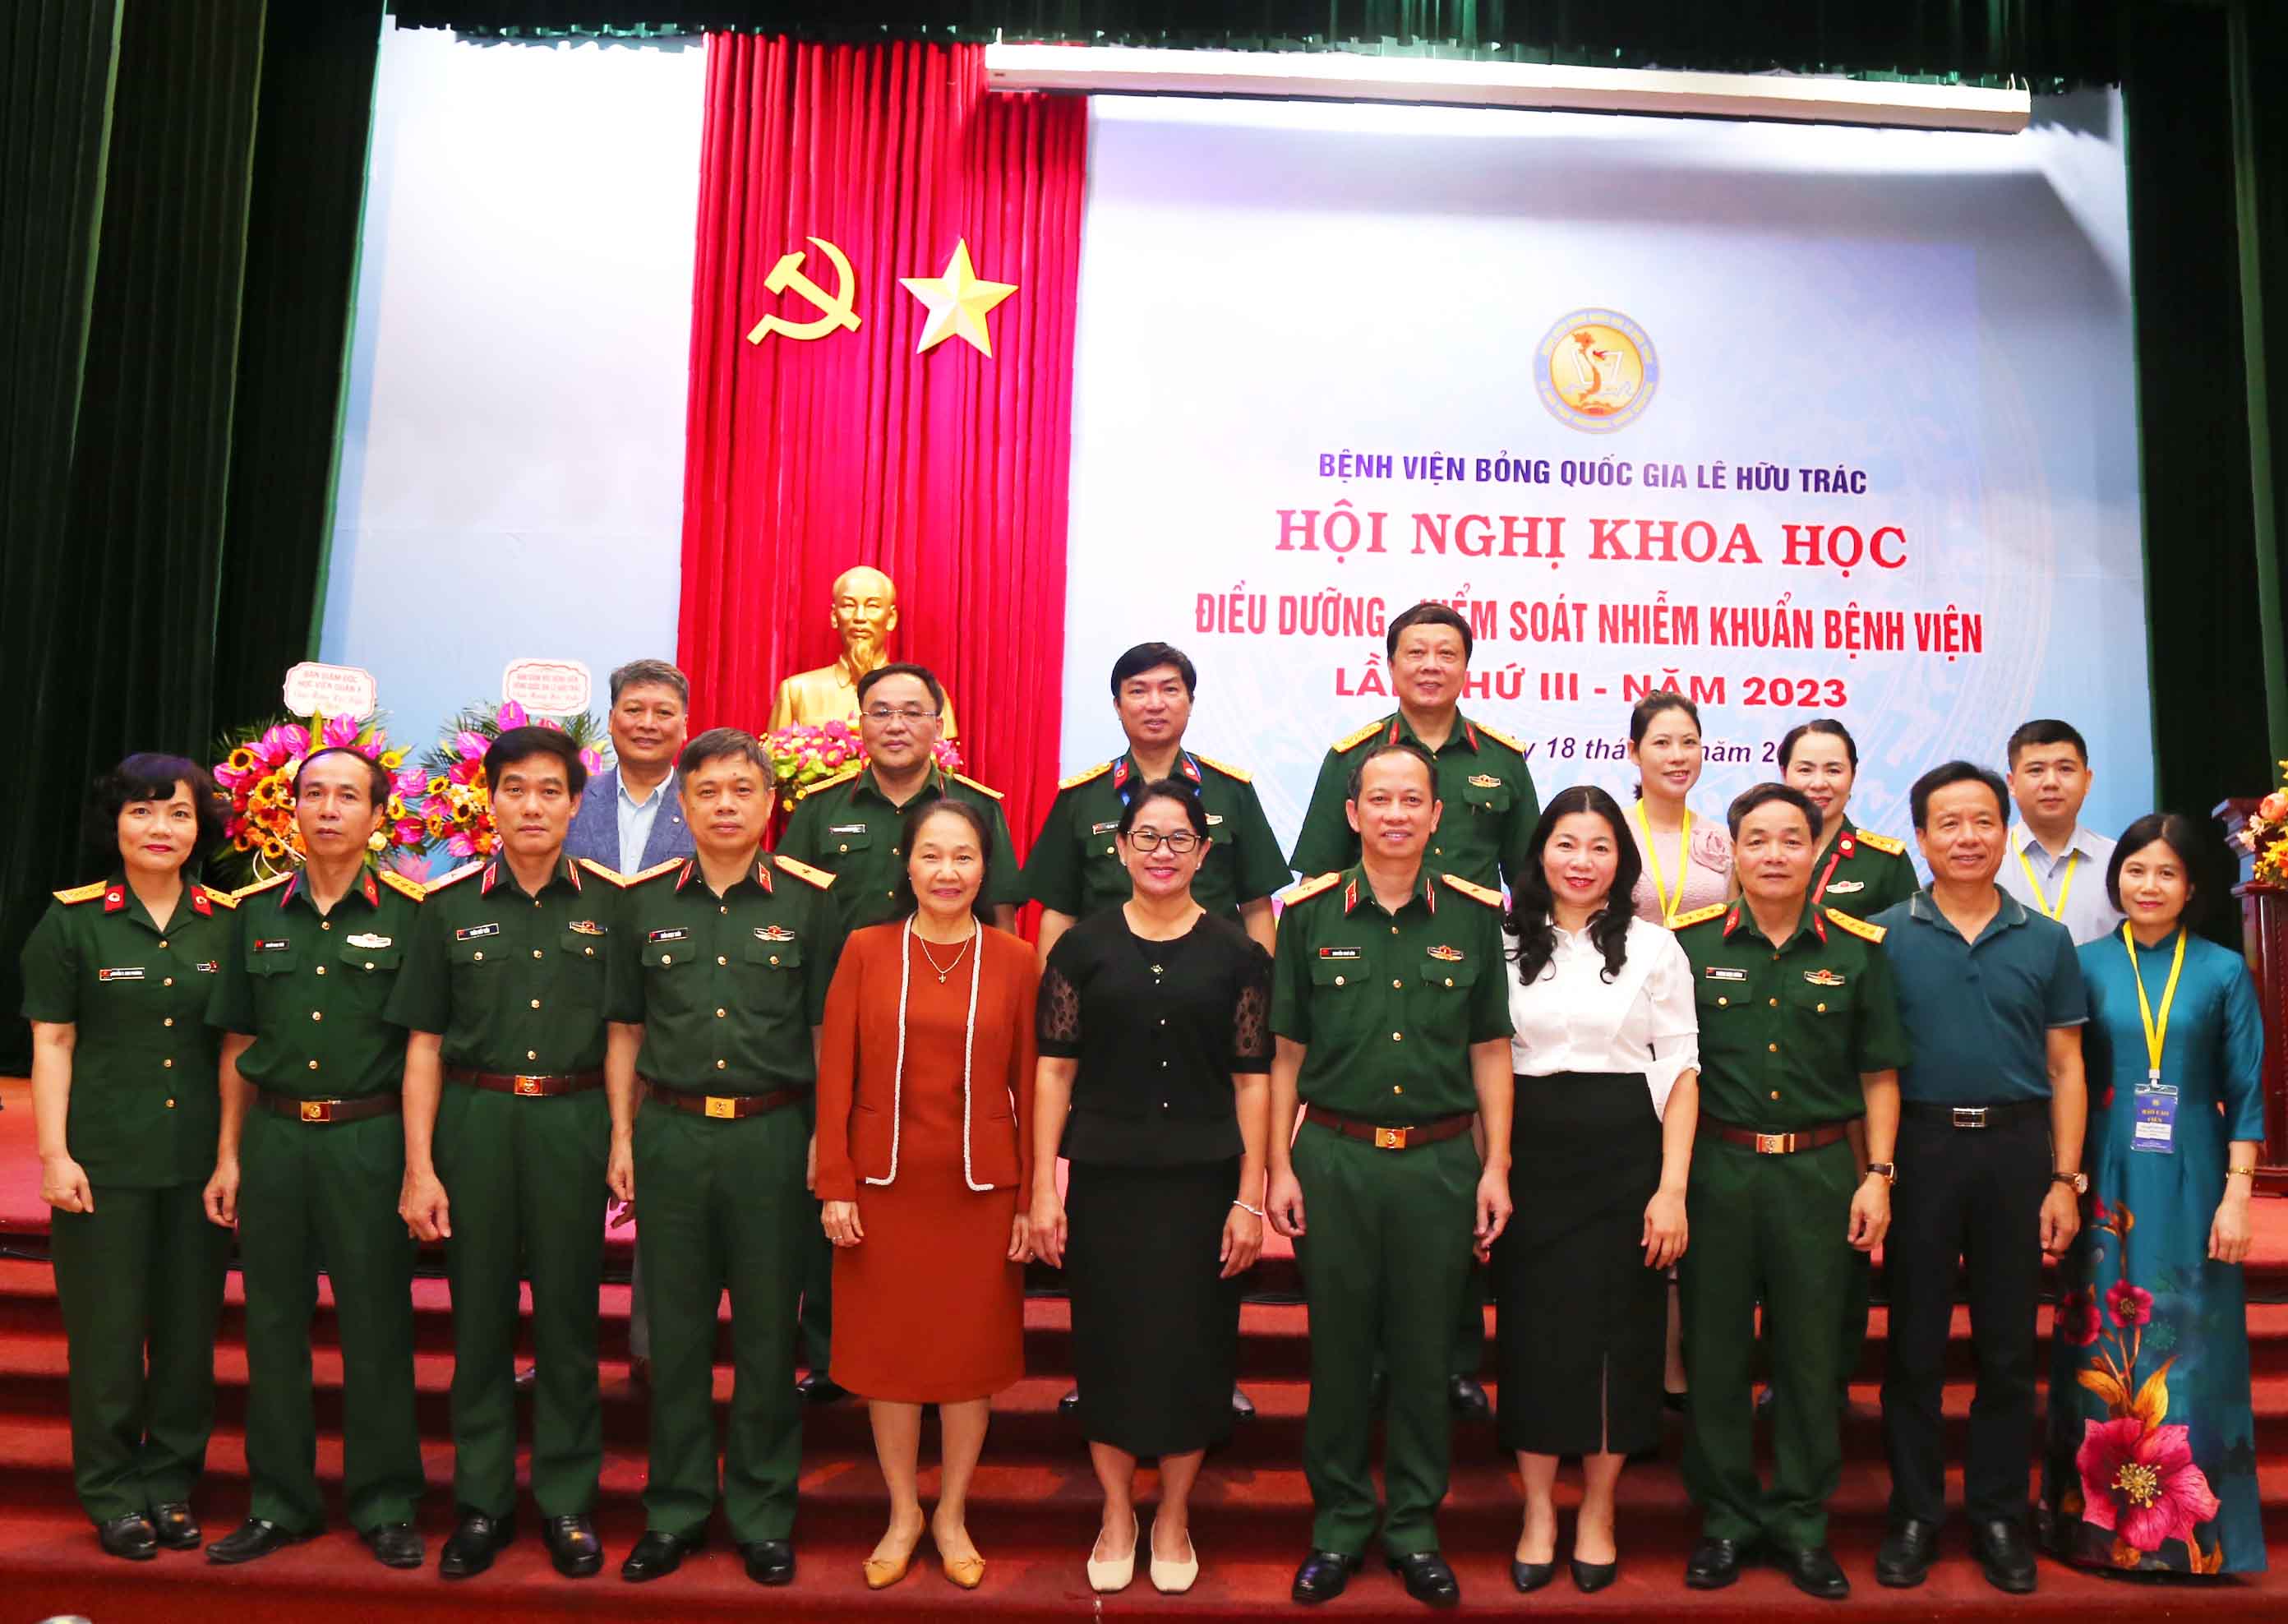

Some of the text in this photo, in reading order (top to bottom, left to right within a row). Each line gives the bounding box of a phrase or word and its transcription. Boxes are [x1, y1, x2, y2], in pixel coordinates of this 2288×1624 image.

[1319, 449, 1867, 495] BỆNH VIỆN BỎNG QUỐC GIA LÊ HỮU TRÁC
[1275, 498, 1907, 579] HỘI NGHỊ KHOA HỌC
[1195, 579, 1267, 634] ĐIỀU
[1279, 587, 1386, 638] DƯỠNG
[1510, 593, 1588, 643] SOÁT
[1598, 589, 1698, 646] NHIỄM
[1710, 591, 1814, 649] KHUẨN
[1824, 602, 1904, 659] BỆNH
[1914, 604, 1983, 662] VIỆN
[1335, 652, 1400, 697] LẦ
[1462, 662, 1525, 700] HỨ
[1540, 672, 1579, 701] III
[1623, 667, 1726, 704] NĂM
[1742, 676, 1847, 708] 2023
[1547, 737, 1575, 759] 18
[1585, 738, 1629, 761] thá
